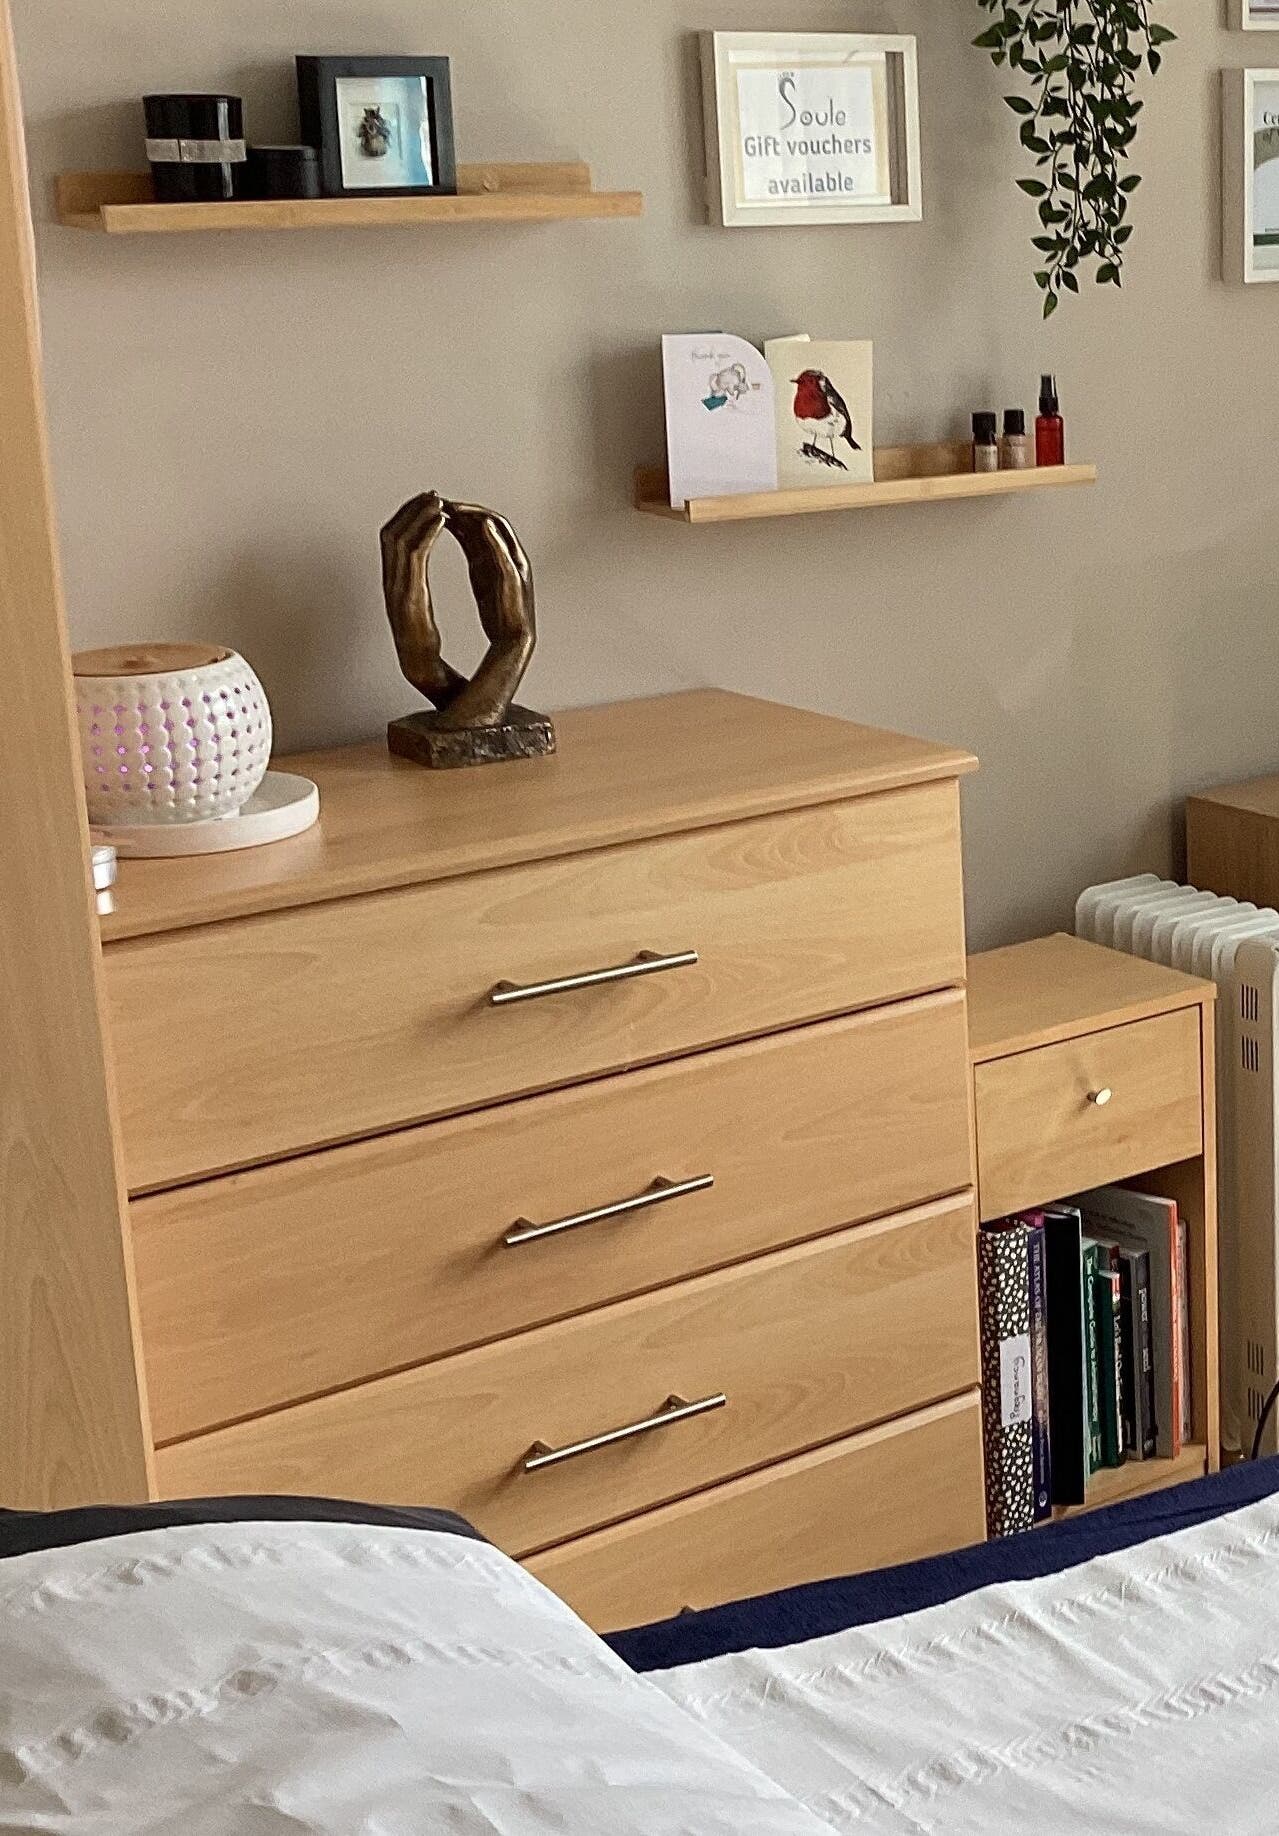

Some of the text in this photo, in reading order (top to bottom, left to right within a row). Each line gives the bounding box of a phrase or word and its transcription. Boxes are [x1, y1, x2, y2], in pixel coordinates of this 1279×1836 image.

[778, 76, 846, 131] Soule
[744, 133, 872, 157] Gift vouchers
[767, 171, 855, 195] available
